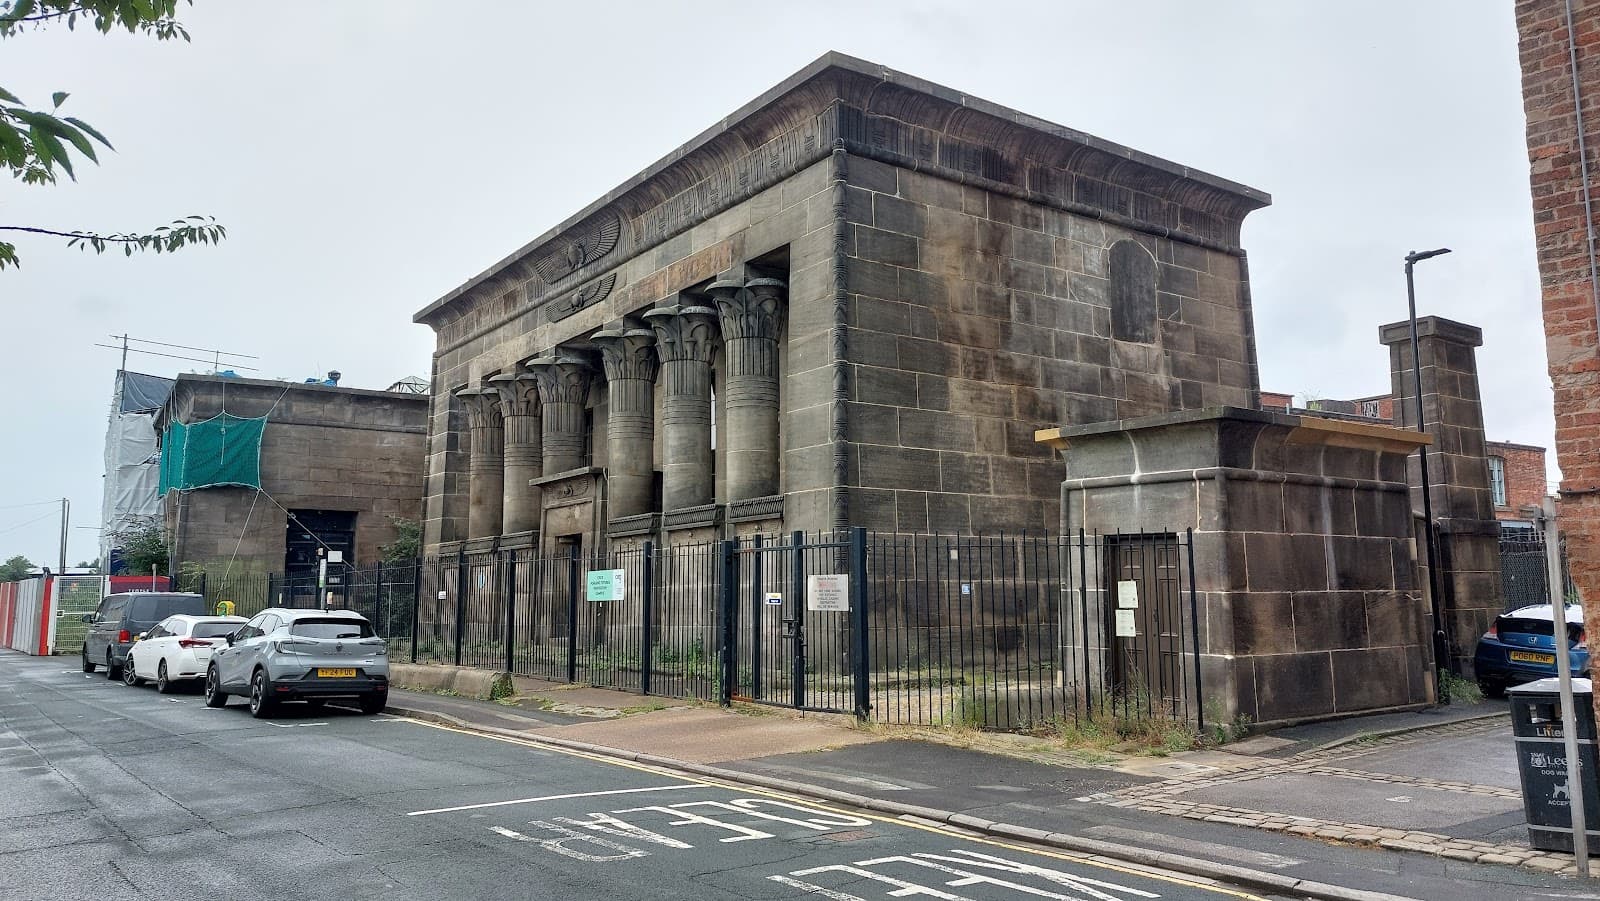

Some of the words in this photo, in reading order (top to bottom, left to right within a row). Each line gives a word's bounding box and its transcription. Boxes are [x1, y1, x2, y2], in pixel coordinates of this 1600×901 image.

[1513, 651, 1534, 660] PO60
[1535, 653, 1551, 662] RNF
[1547, 755, 1584, 768] Lees
[766, 850, 1161, 901] KEE
